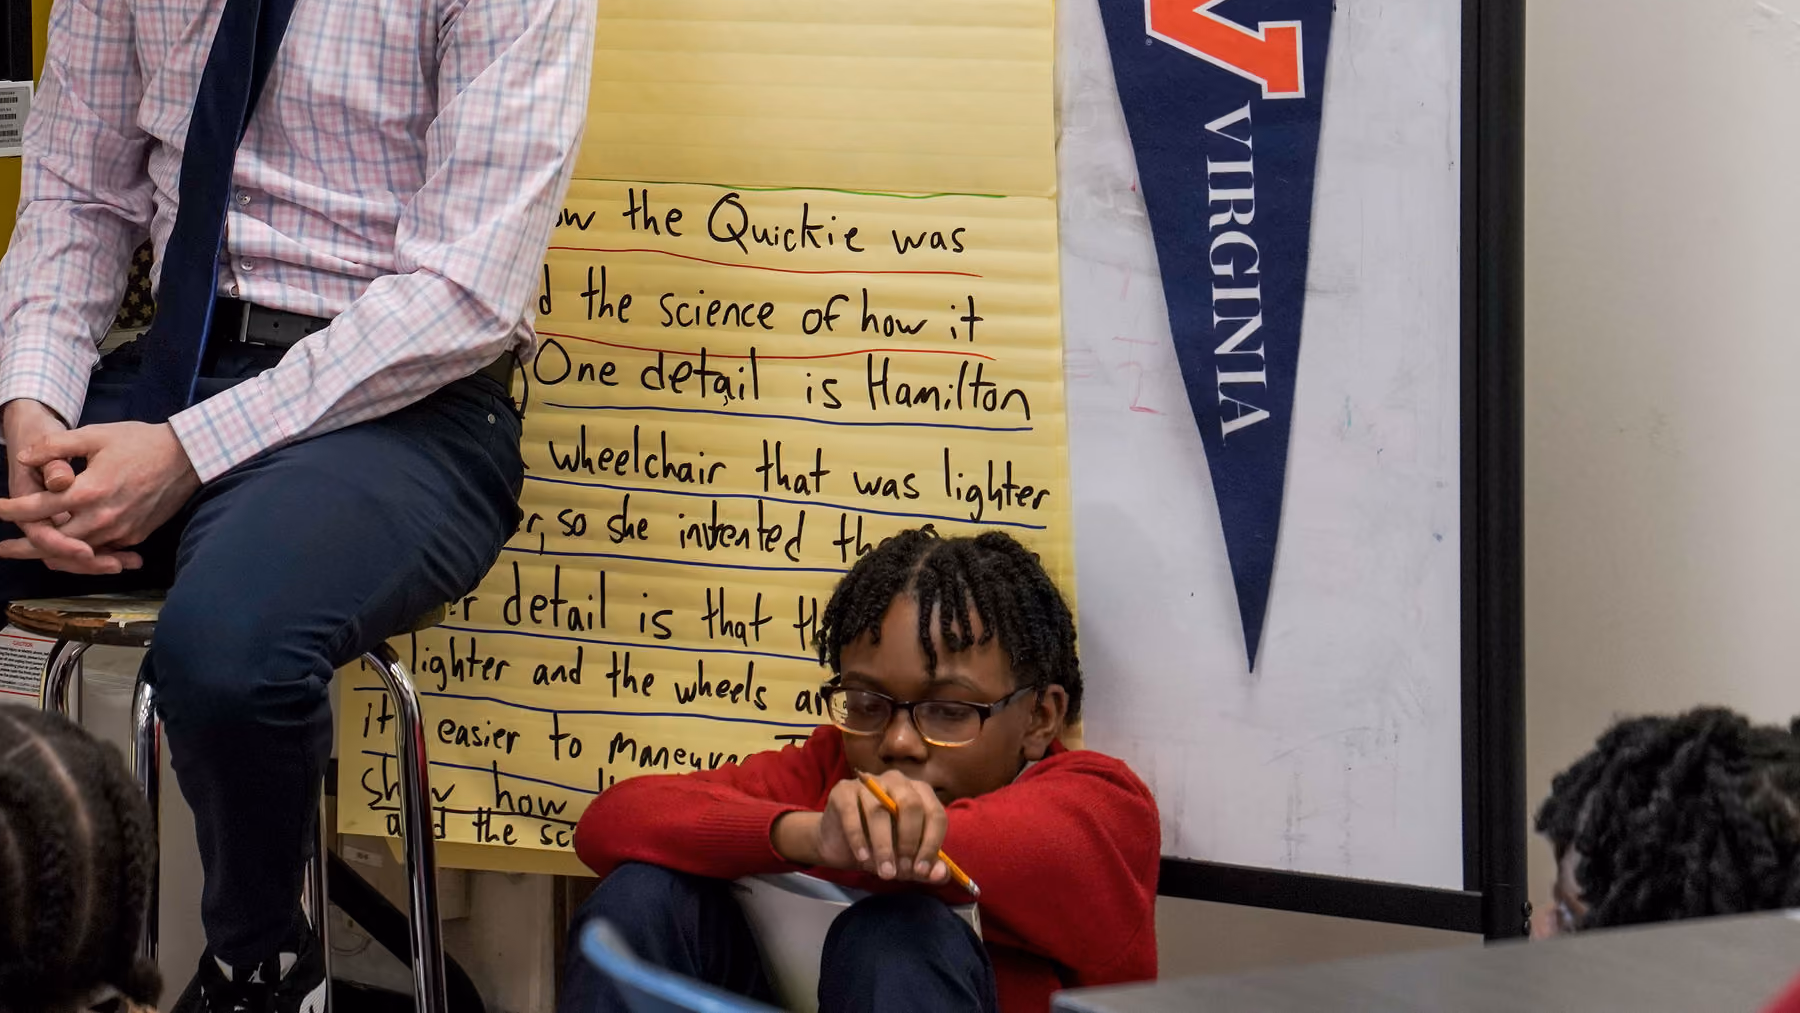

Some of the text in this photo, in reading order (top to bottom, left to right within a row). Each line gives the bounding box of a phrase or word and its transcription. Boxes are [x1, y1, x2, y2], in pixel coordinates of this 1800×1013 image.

[622, 187, 683, 237] the
[707, 192, 865, 255] Quickie
[892, 226, 966, 255] was
[580, 265, 632, 323] the
[660, 289, 776, 330] science
[802, 295, 849, 335] of
[862, 288, 928, 334] how
[951, 295, 984, 342] it
[1204, 100, 1271, 446] VIRGINIA
[533, 338, 1031, 421] One detail is Hamilton
[549, 424, 1051, 524] wheelchair that was lighter
[557, 508, 587, 538] so
[607, 493, 649, 544] she
[503, 560, 607, 632] detail
[639, 591, 673, 639] is
[701, 587, 774, 648] that
[411, 627, 510, 692] lighter
[533, 646, 584, 686] and
[605, 651, 655, 698] the
[674, 659, 768, 712] wheels
[438, 714, 521, 757] easier
[549, 711, 583, 761] to
[472, 807, 519, 846] the
[494, 760, 568, 816] how
